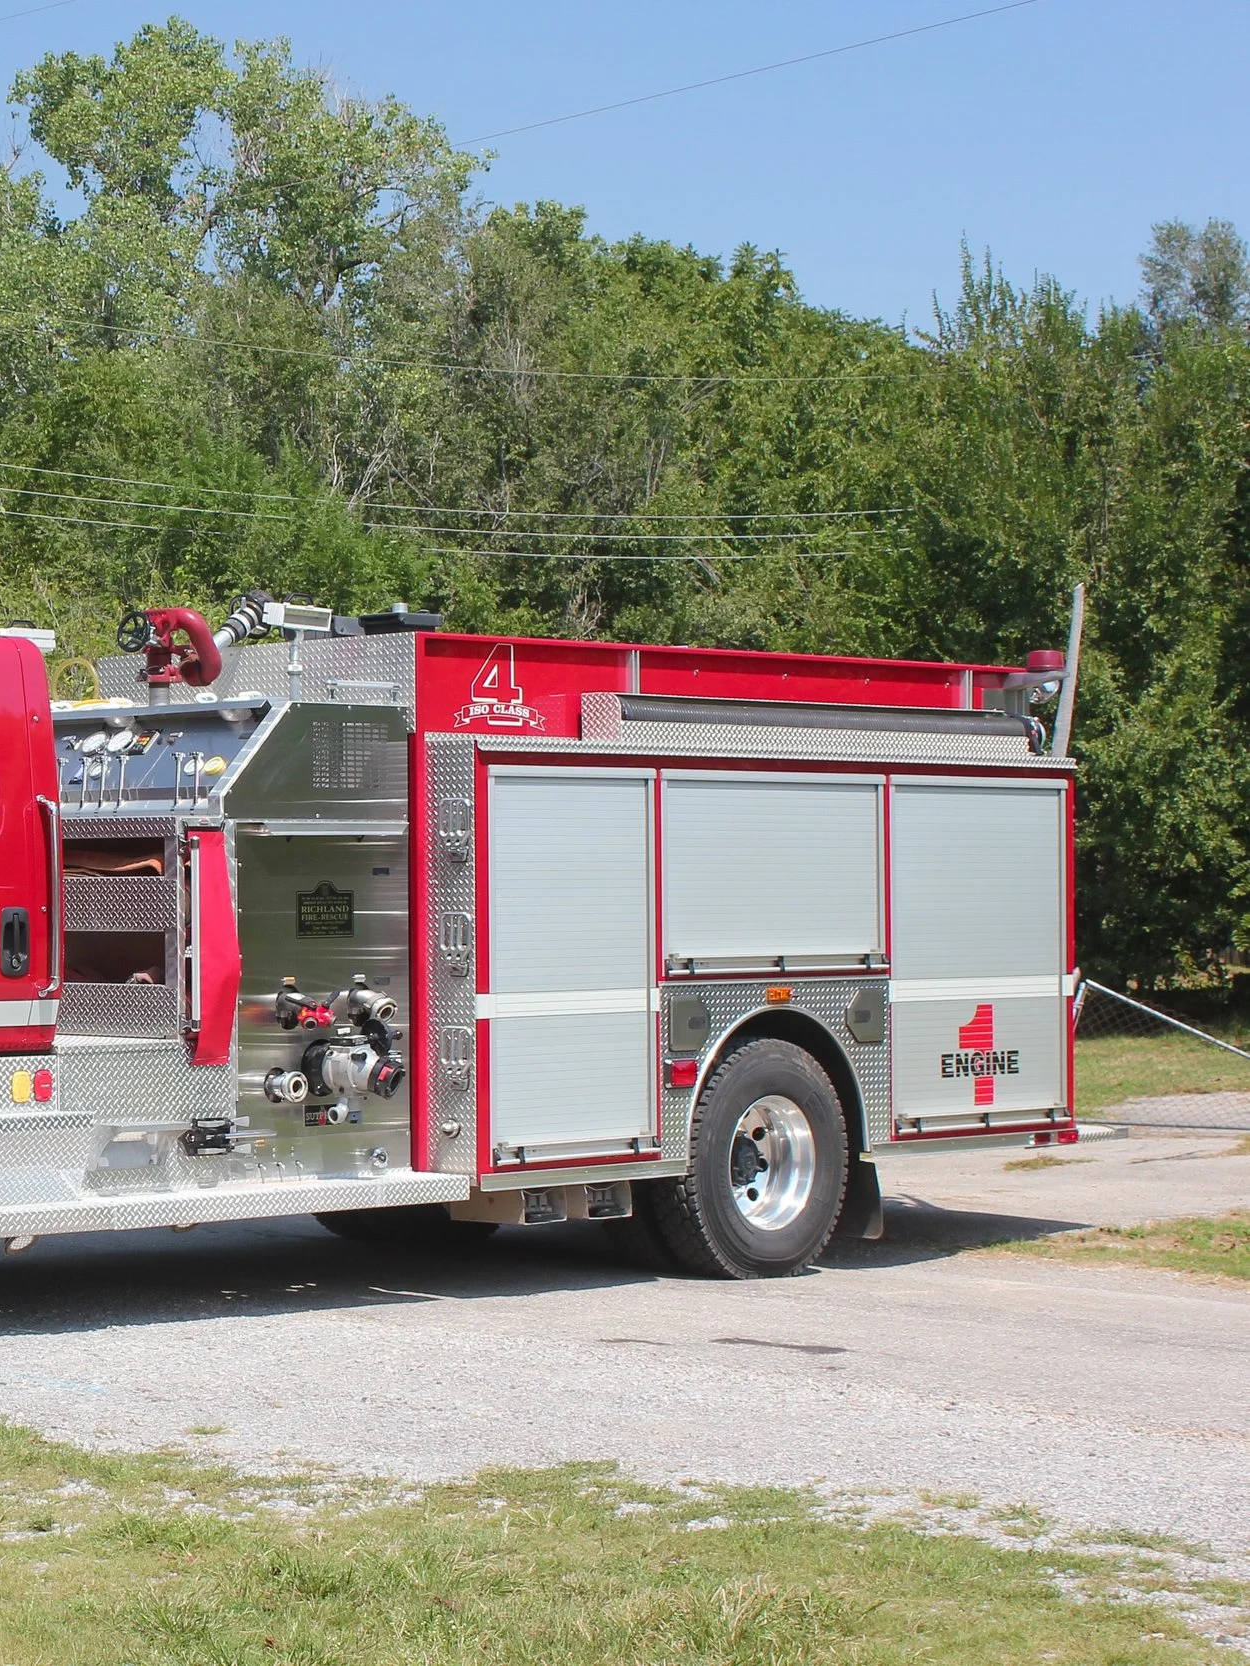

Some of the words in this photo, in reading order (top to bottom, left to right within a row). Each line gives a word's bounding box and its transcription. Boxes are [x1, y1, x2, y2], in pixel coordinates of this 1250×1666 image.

[471, 643, 523, 726] 4
[468, 704, 489, 717] ISO
[493, 704, 530, 718] CLASS
[301, 905, 350, 913] RICHLAND
[301, 913, 349, 921] FIRE-RESCUE
[941, 1049, 1020, 1079] ENGINE
[958, 1003, 994, 1107] 1
